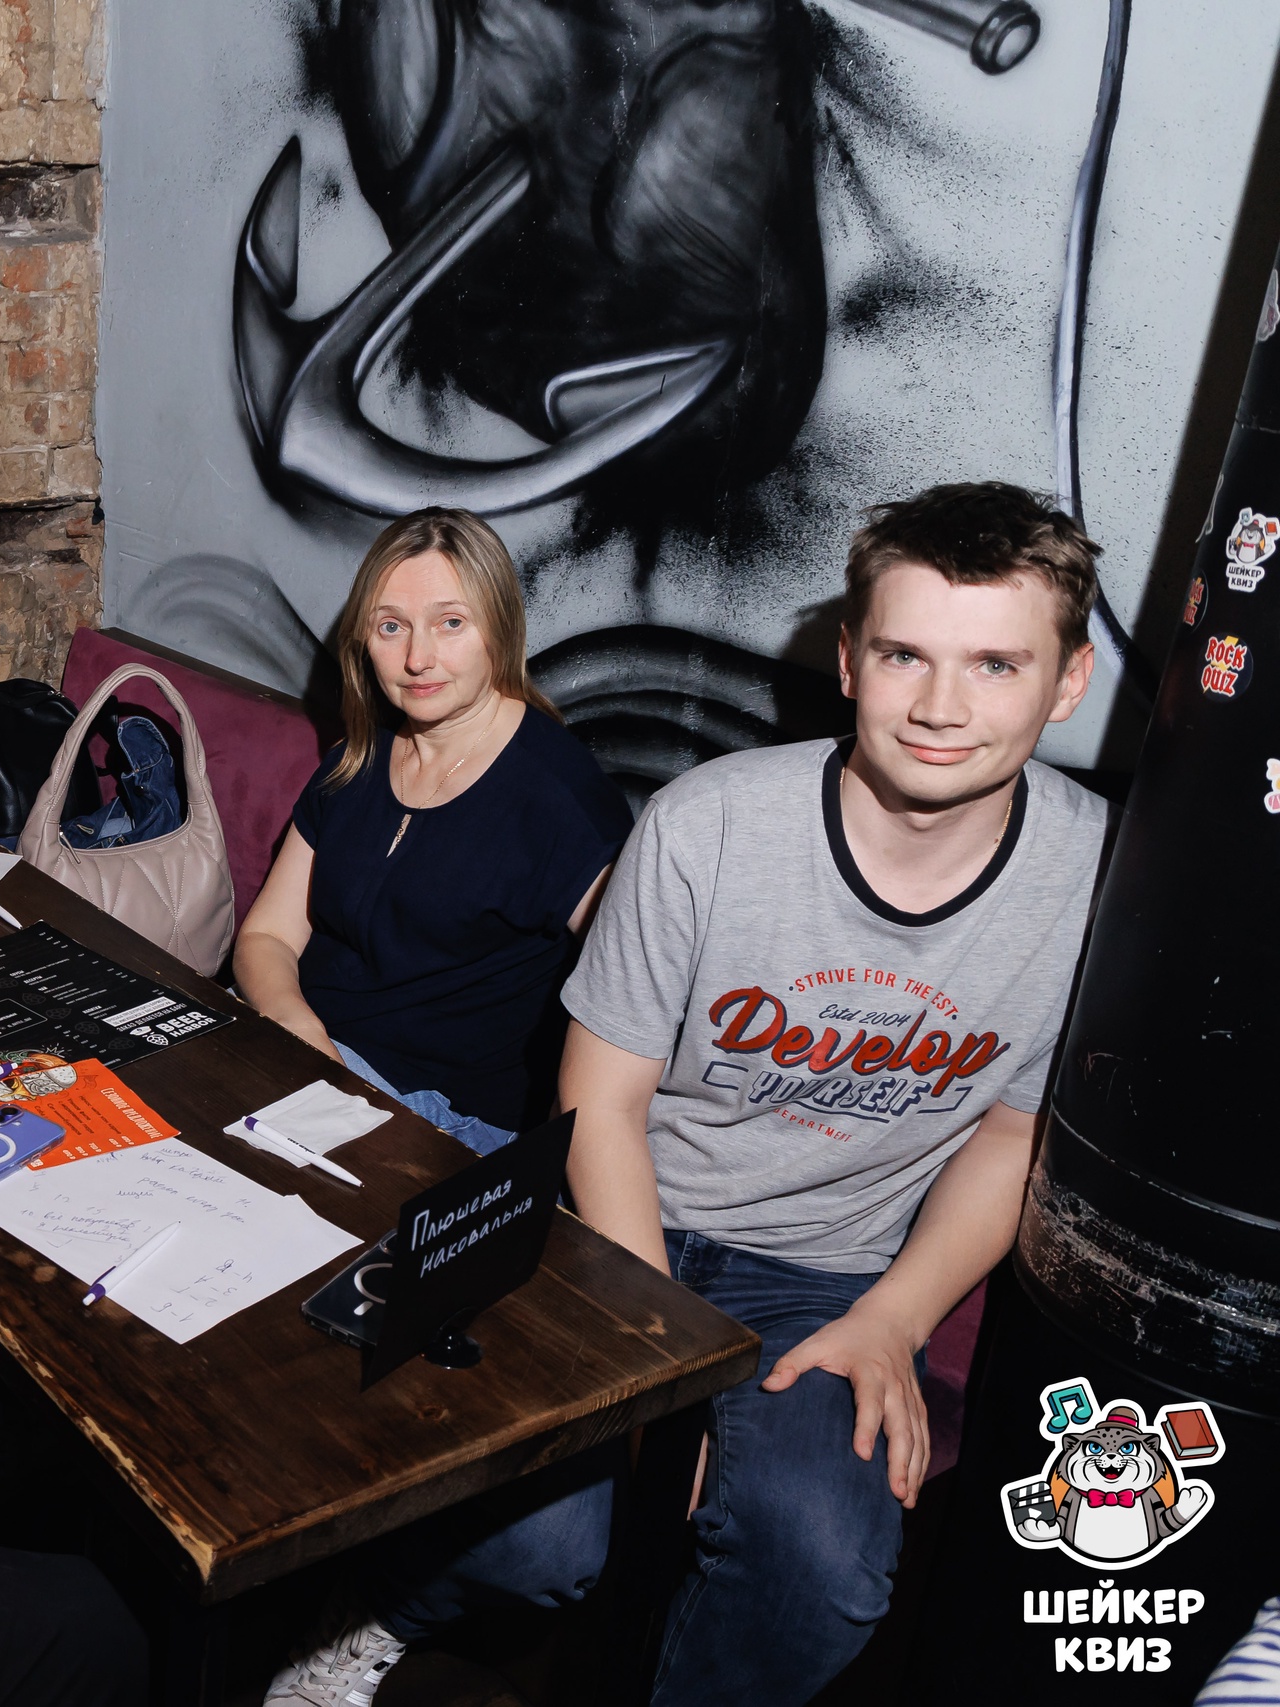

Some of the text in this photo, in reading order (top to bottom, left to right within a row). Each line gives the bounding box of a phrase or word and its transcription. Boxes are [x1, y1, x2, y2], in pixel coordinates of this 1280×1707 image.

[1228, 565, 1262, 579] ШЕЙКЕР
[1231, 578, 1253, 588] КВИЗ
[1206, 637, 1247, 670] ROCK
[1201, 666, 1238, 697] QUIZ
[795, 968, 856, 993] STRIVE
[864, 968, 897, 988] FOR
[904, 978, 934, 1000] THE
[155, 1010, 207, 1032] BEER
[170, 1017, 217, 1037] HARBOR
[818, 1004, 912, 1028] Estd 2004
[709, 985, 1011, 1098] Develop
[748, 1070, 932, 1117] YOURSELF
[411, 1179, 512, 1251] Плюшевая
[420, 1196, 533, 1278] наковальня
